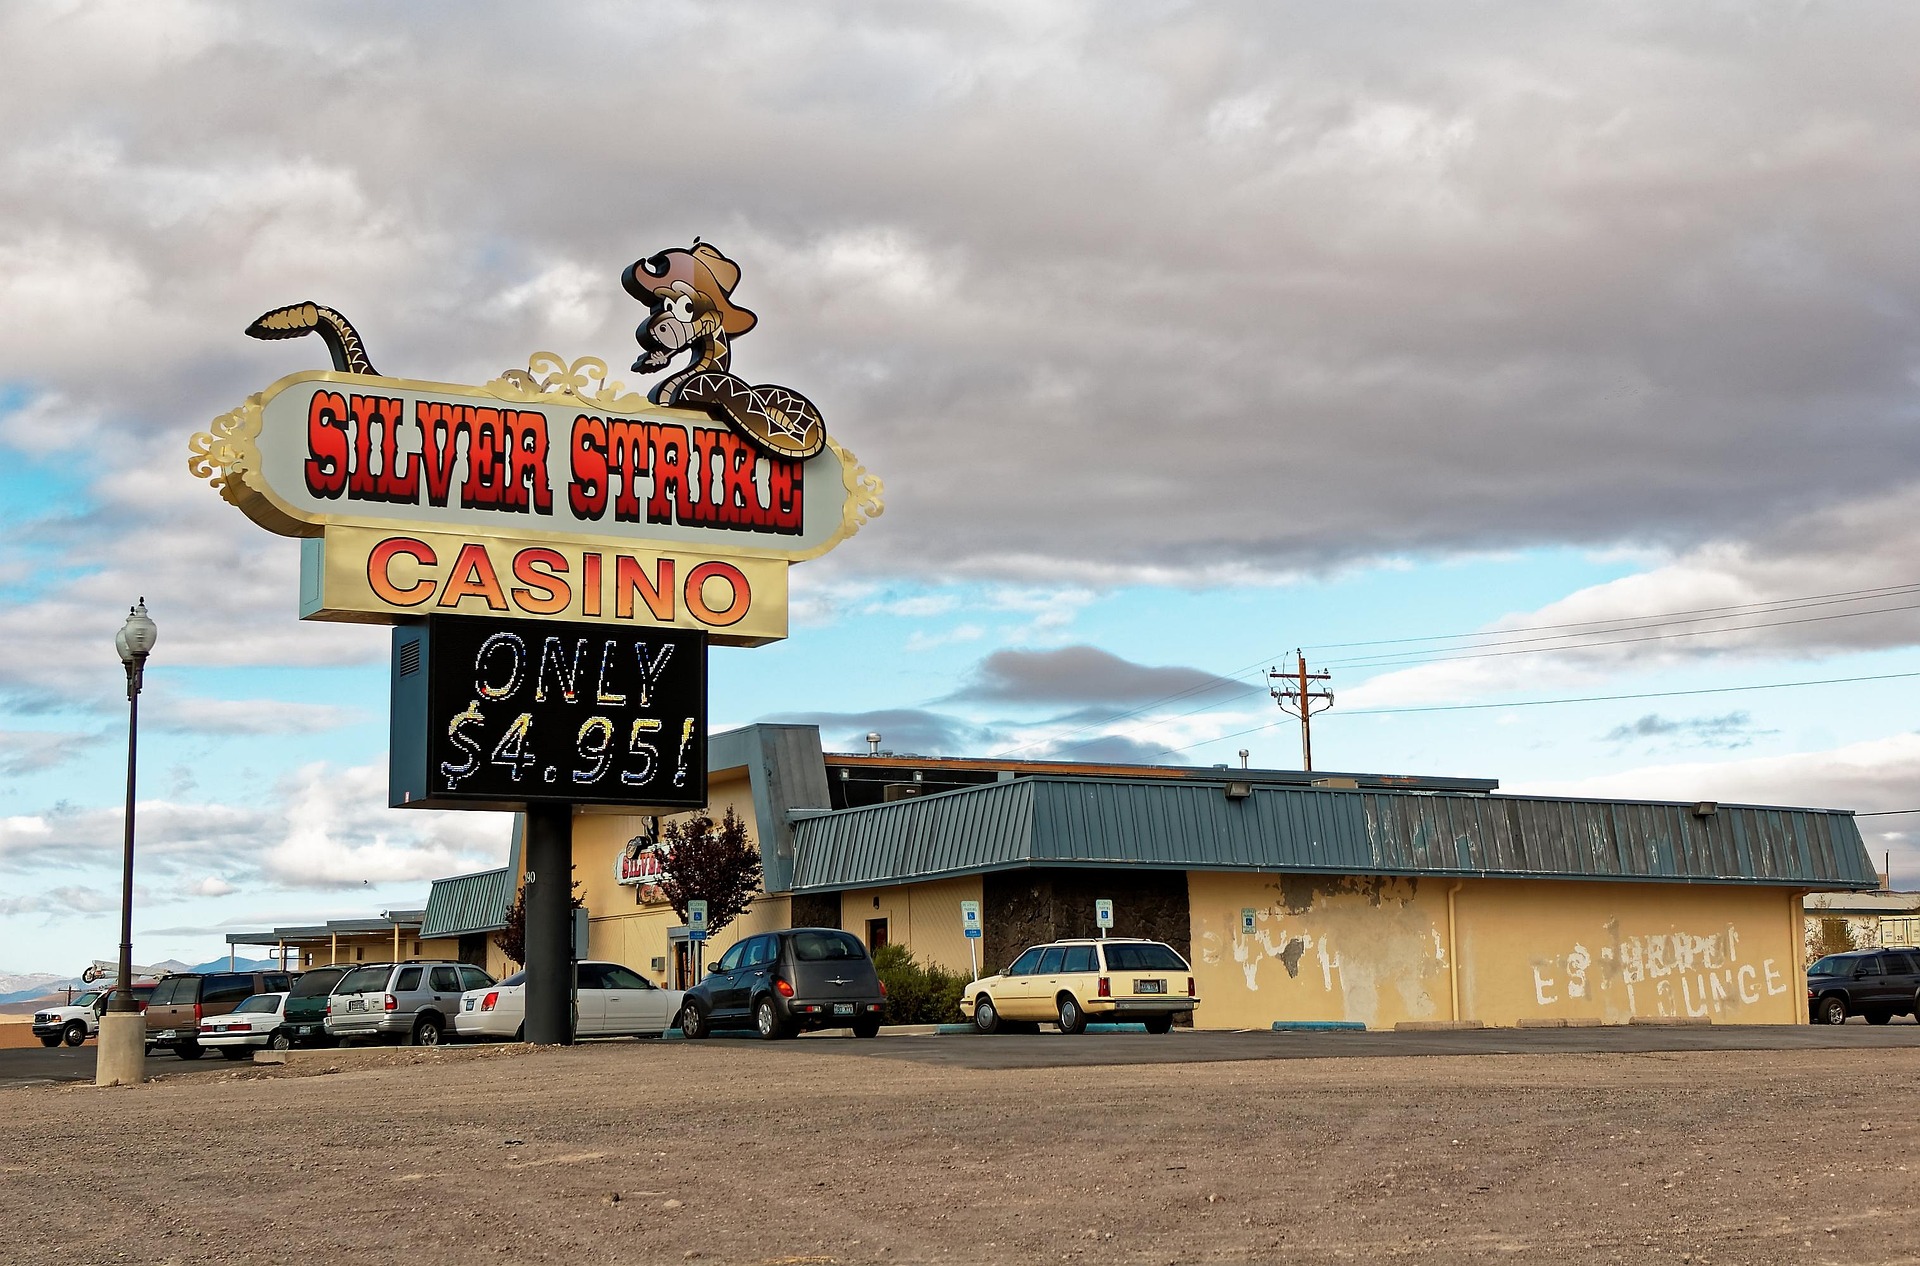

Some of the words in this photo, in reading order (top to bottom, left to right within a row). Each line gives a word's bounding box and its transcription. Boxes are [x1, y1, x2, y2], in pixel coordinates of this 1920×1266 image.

[305, 390, 553, 515] SILVER
[568, 415, 804, 536] STRIKE
[366, 536, 752, 628] CASINO
[475, 631, 675, 708] ONLY
[440, 699, 695, 790] $4.95!
